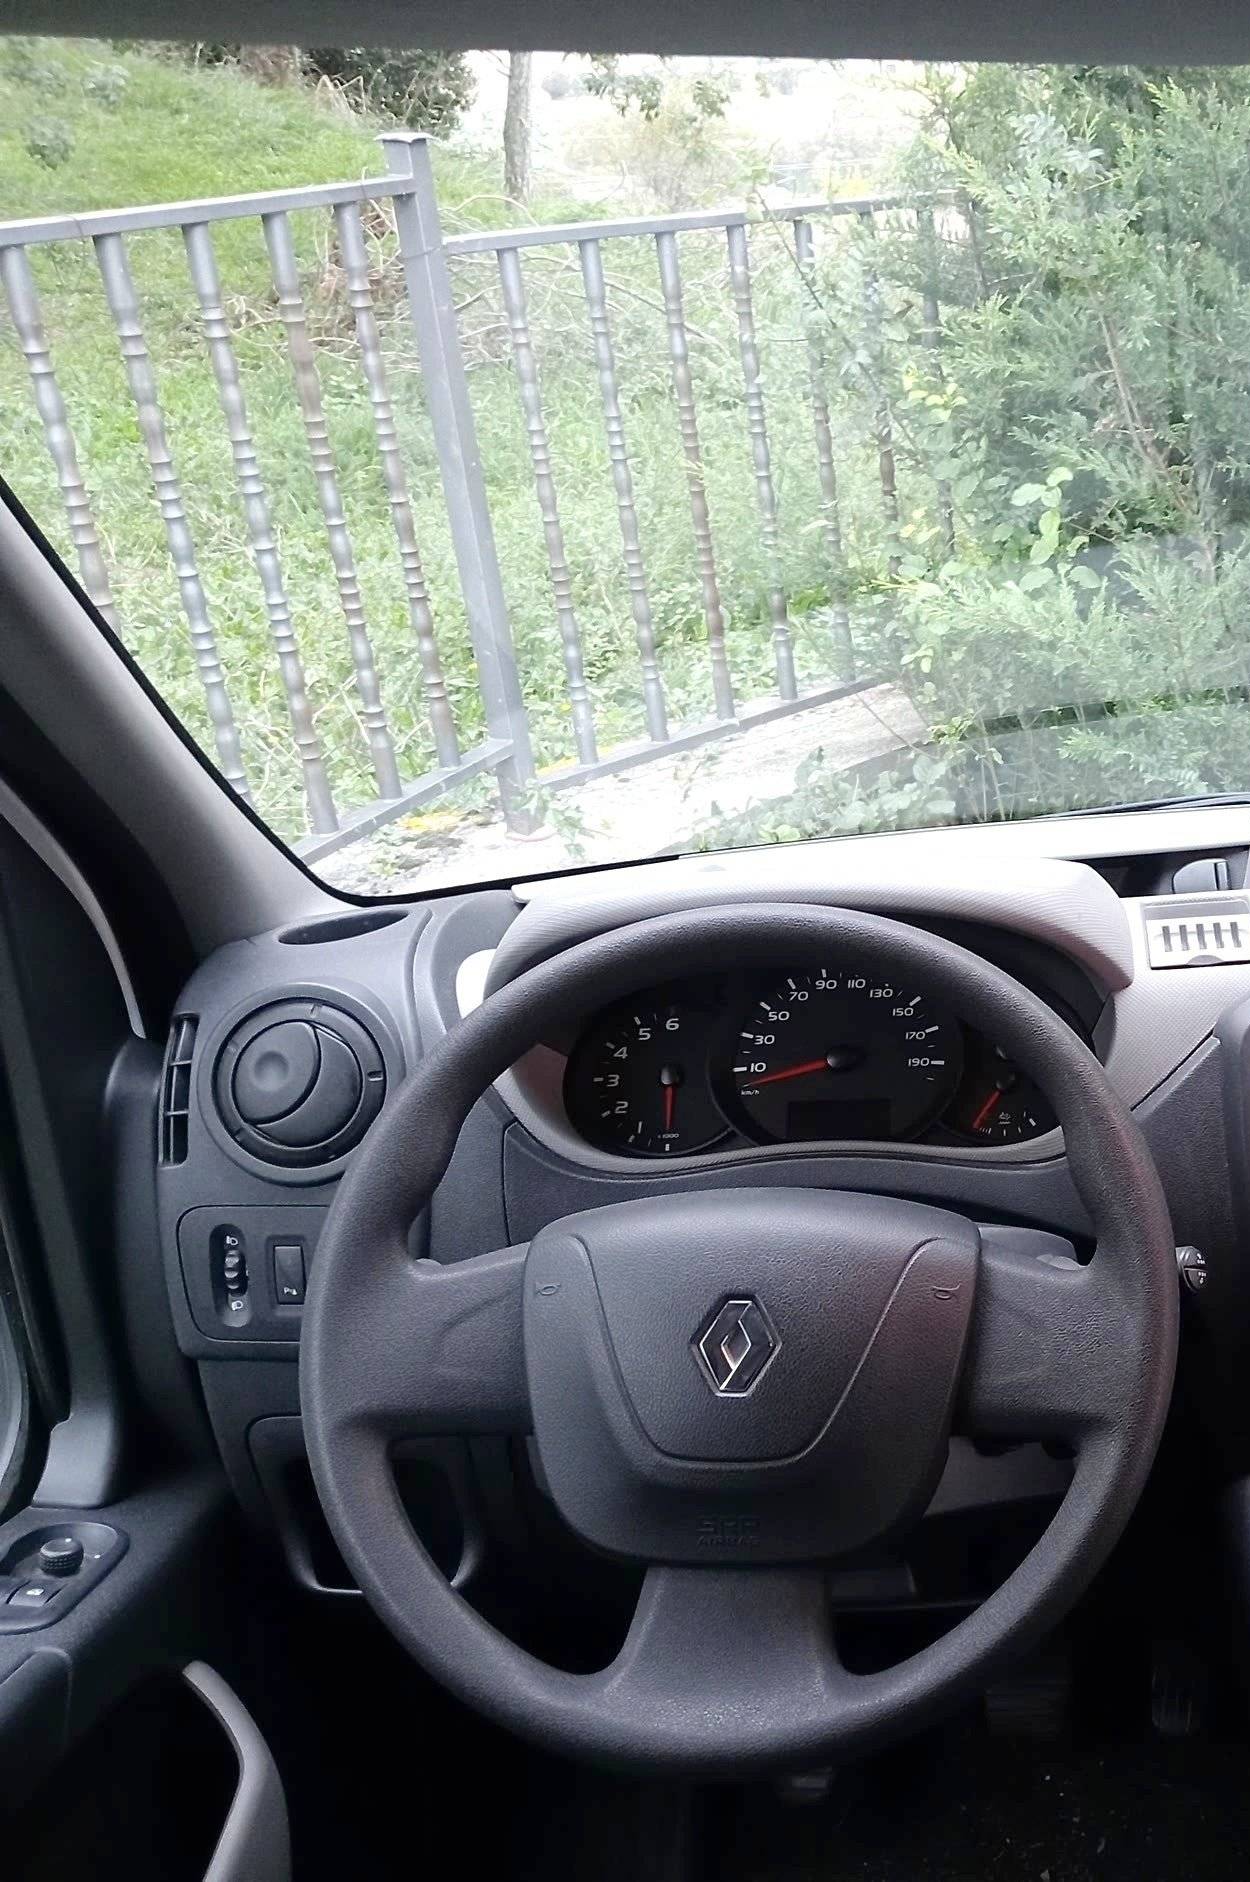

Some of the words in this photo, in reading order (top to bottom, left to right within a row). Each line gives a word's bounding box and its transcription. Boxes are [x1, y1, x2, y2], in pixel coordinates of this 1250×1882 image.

[814, 979, 837, 990] 90
[847, 978, 866, 989] 110
[788, 991, 809, 1001] 70
[869, 988, 893, 998] 130
[768, 1011, 790, 1021] 50
[892, 1007, 914, 1016] 150
[665, 1018, 680, 1030] 6
[638, 1028, 651, 1040] 5
[754, 1034, 775, 1045] 30
[905, 1031, 926, 1040] 170
[613, 1046, 628, 1059] 4
[750, 1062, 767, 1073] 10
[908, 1057, 930, 1067] 190
[607, 1074, 620, 1087] 3
[614, 1101, 628, 1113] 2
